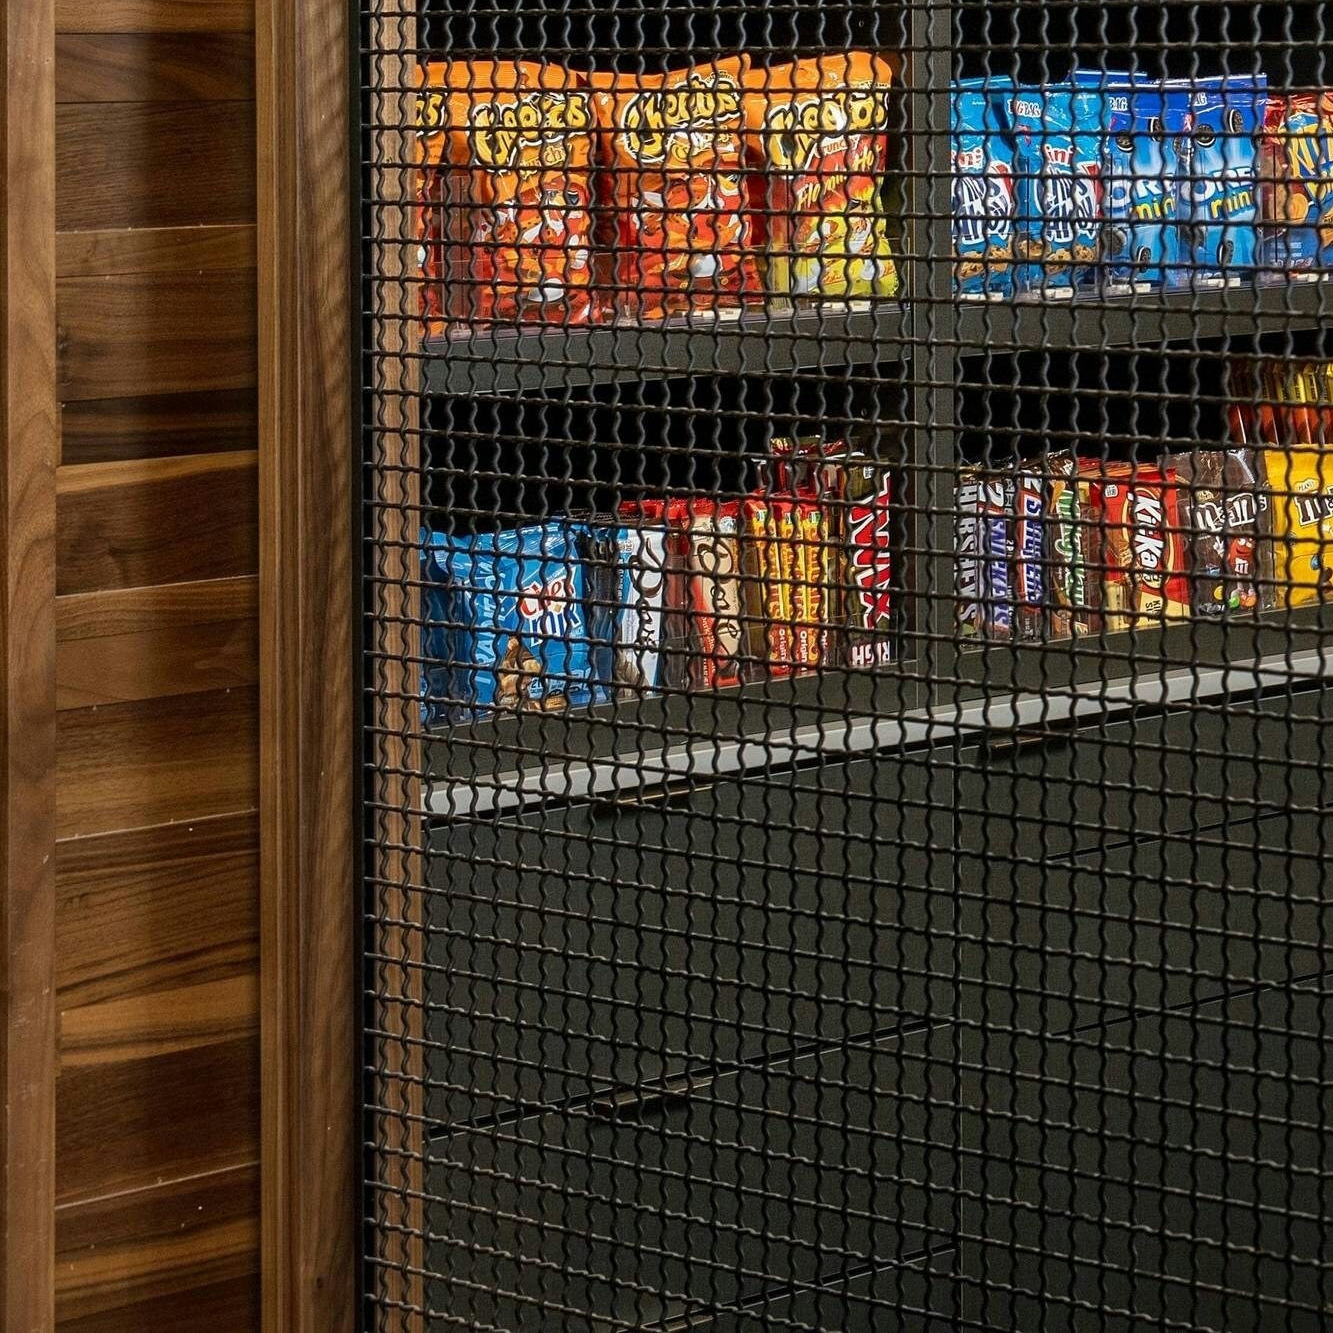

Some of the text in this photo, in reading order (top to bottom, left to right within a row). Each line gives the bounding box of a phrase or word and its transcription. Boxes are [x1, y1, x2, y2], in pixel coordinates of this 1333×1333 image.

[1044, 143, 1074, 167] ini
[779, 628, 788, 668] Originl
[799, 629, 808, 670] Originl
